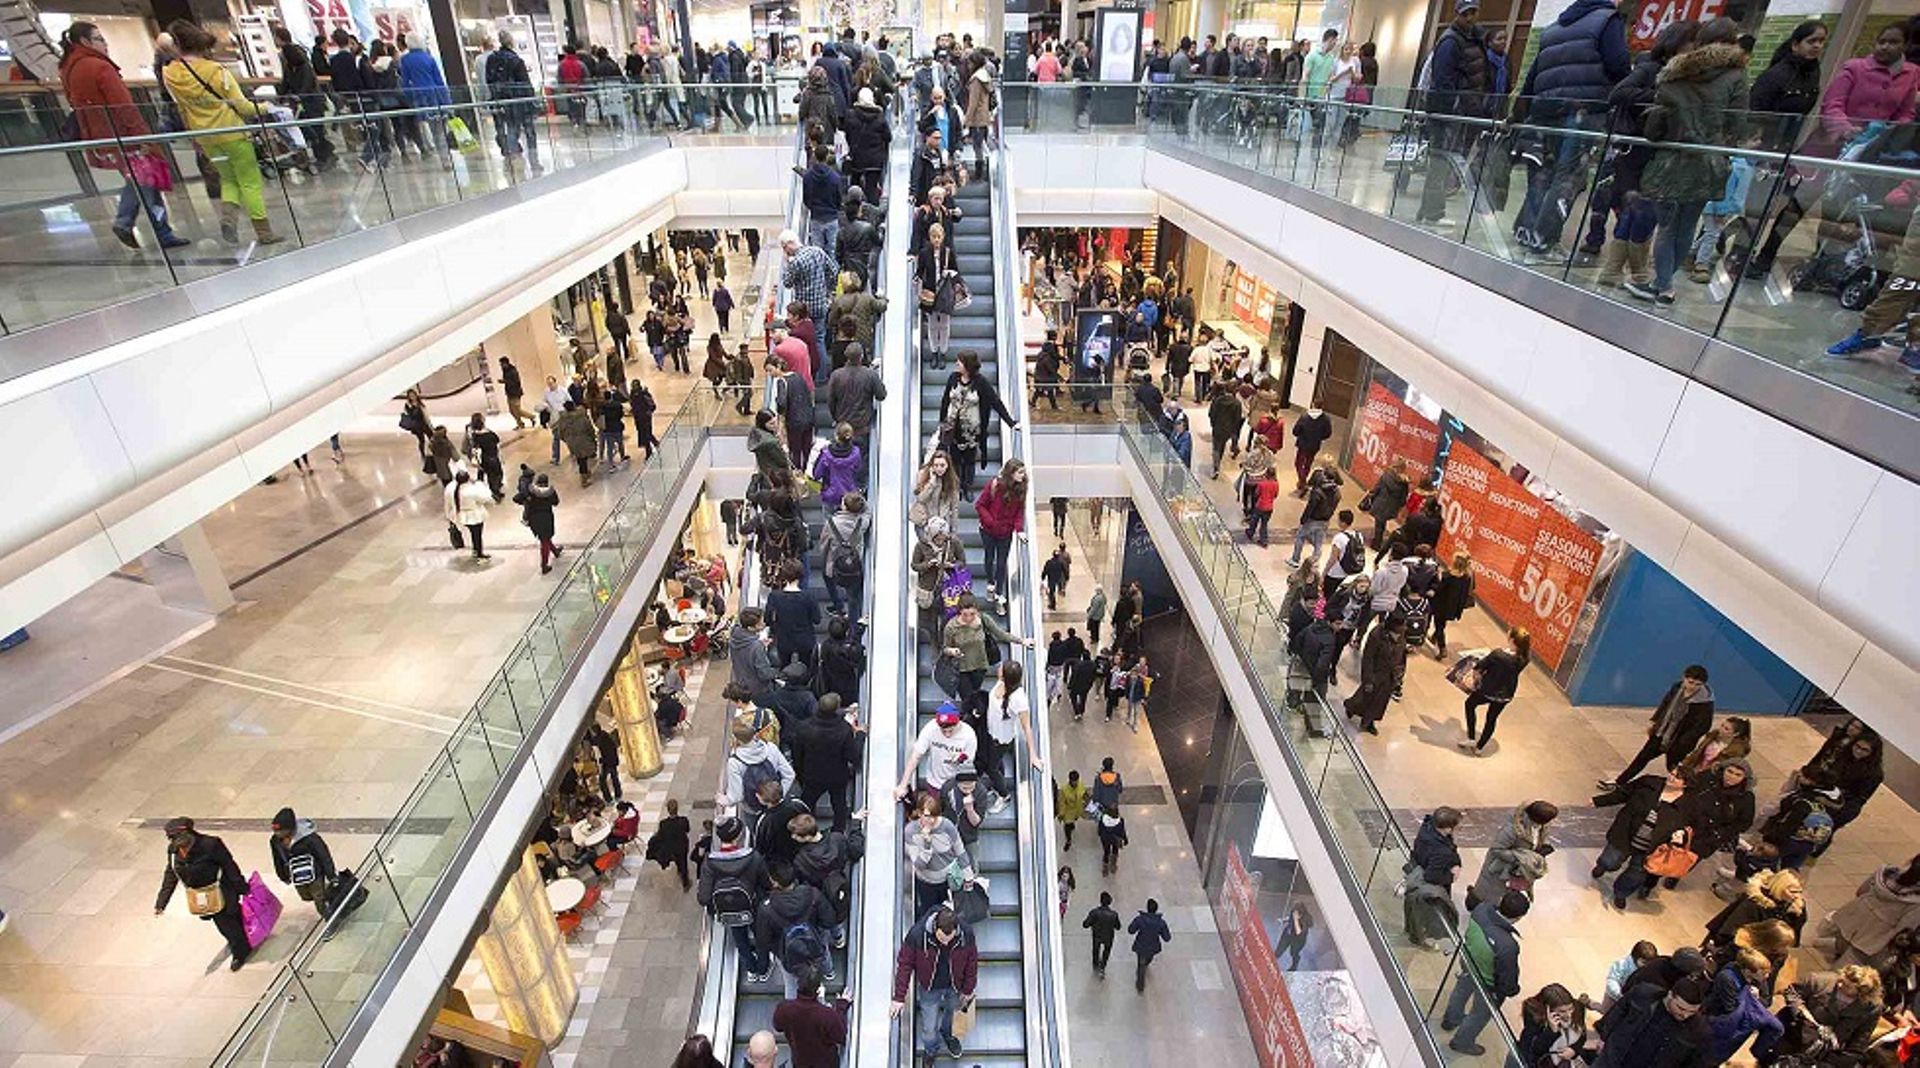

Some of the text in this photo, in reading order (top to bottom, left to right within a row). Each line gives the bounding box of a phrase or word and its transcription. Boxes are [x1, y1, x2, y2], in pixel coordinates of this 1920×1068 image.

[1357, 424, 1389, 465] 50%
[1488, 491, 1540, 520] REDUCTIONS
[1478, 526, 1527, 555] REDUCTIONS
[1532, 541, 1593, 577] REDUCTIONS
[1537, 529, 1596, 567] SEASONAL
[1518, 562, 1576, 628] 50%
